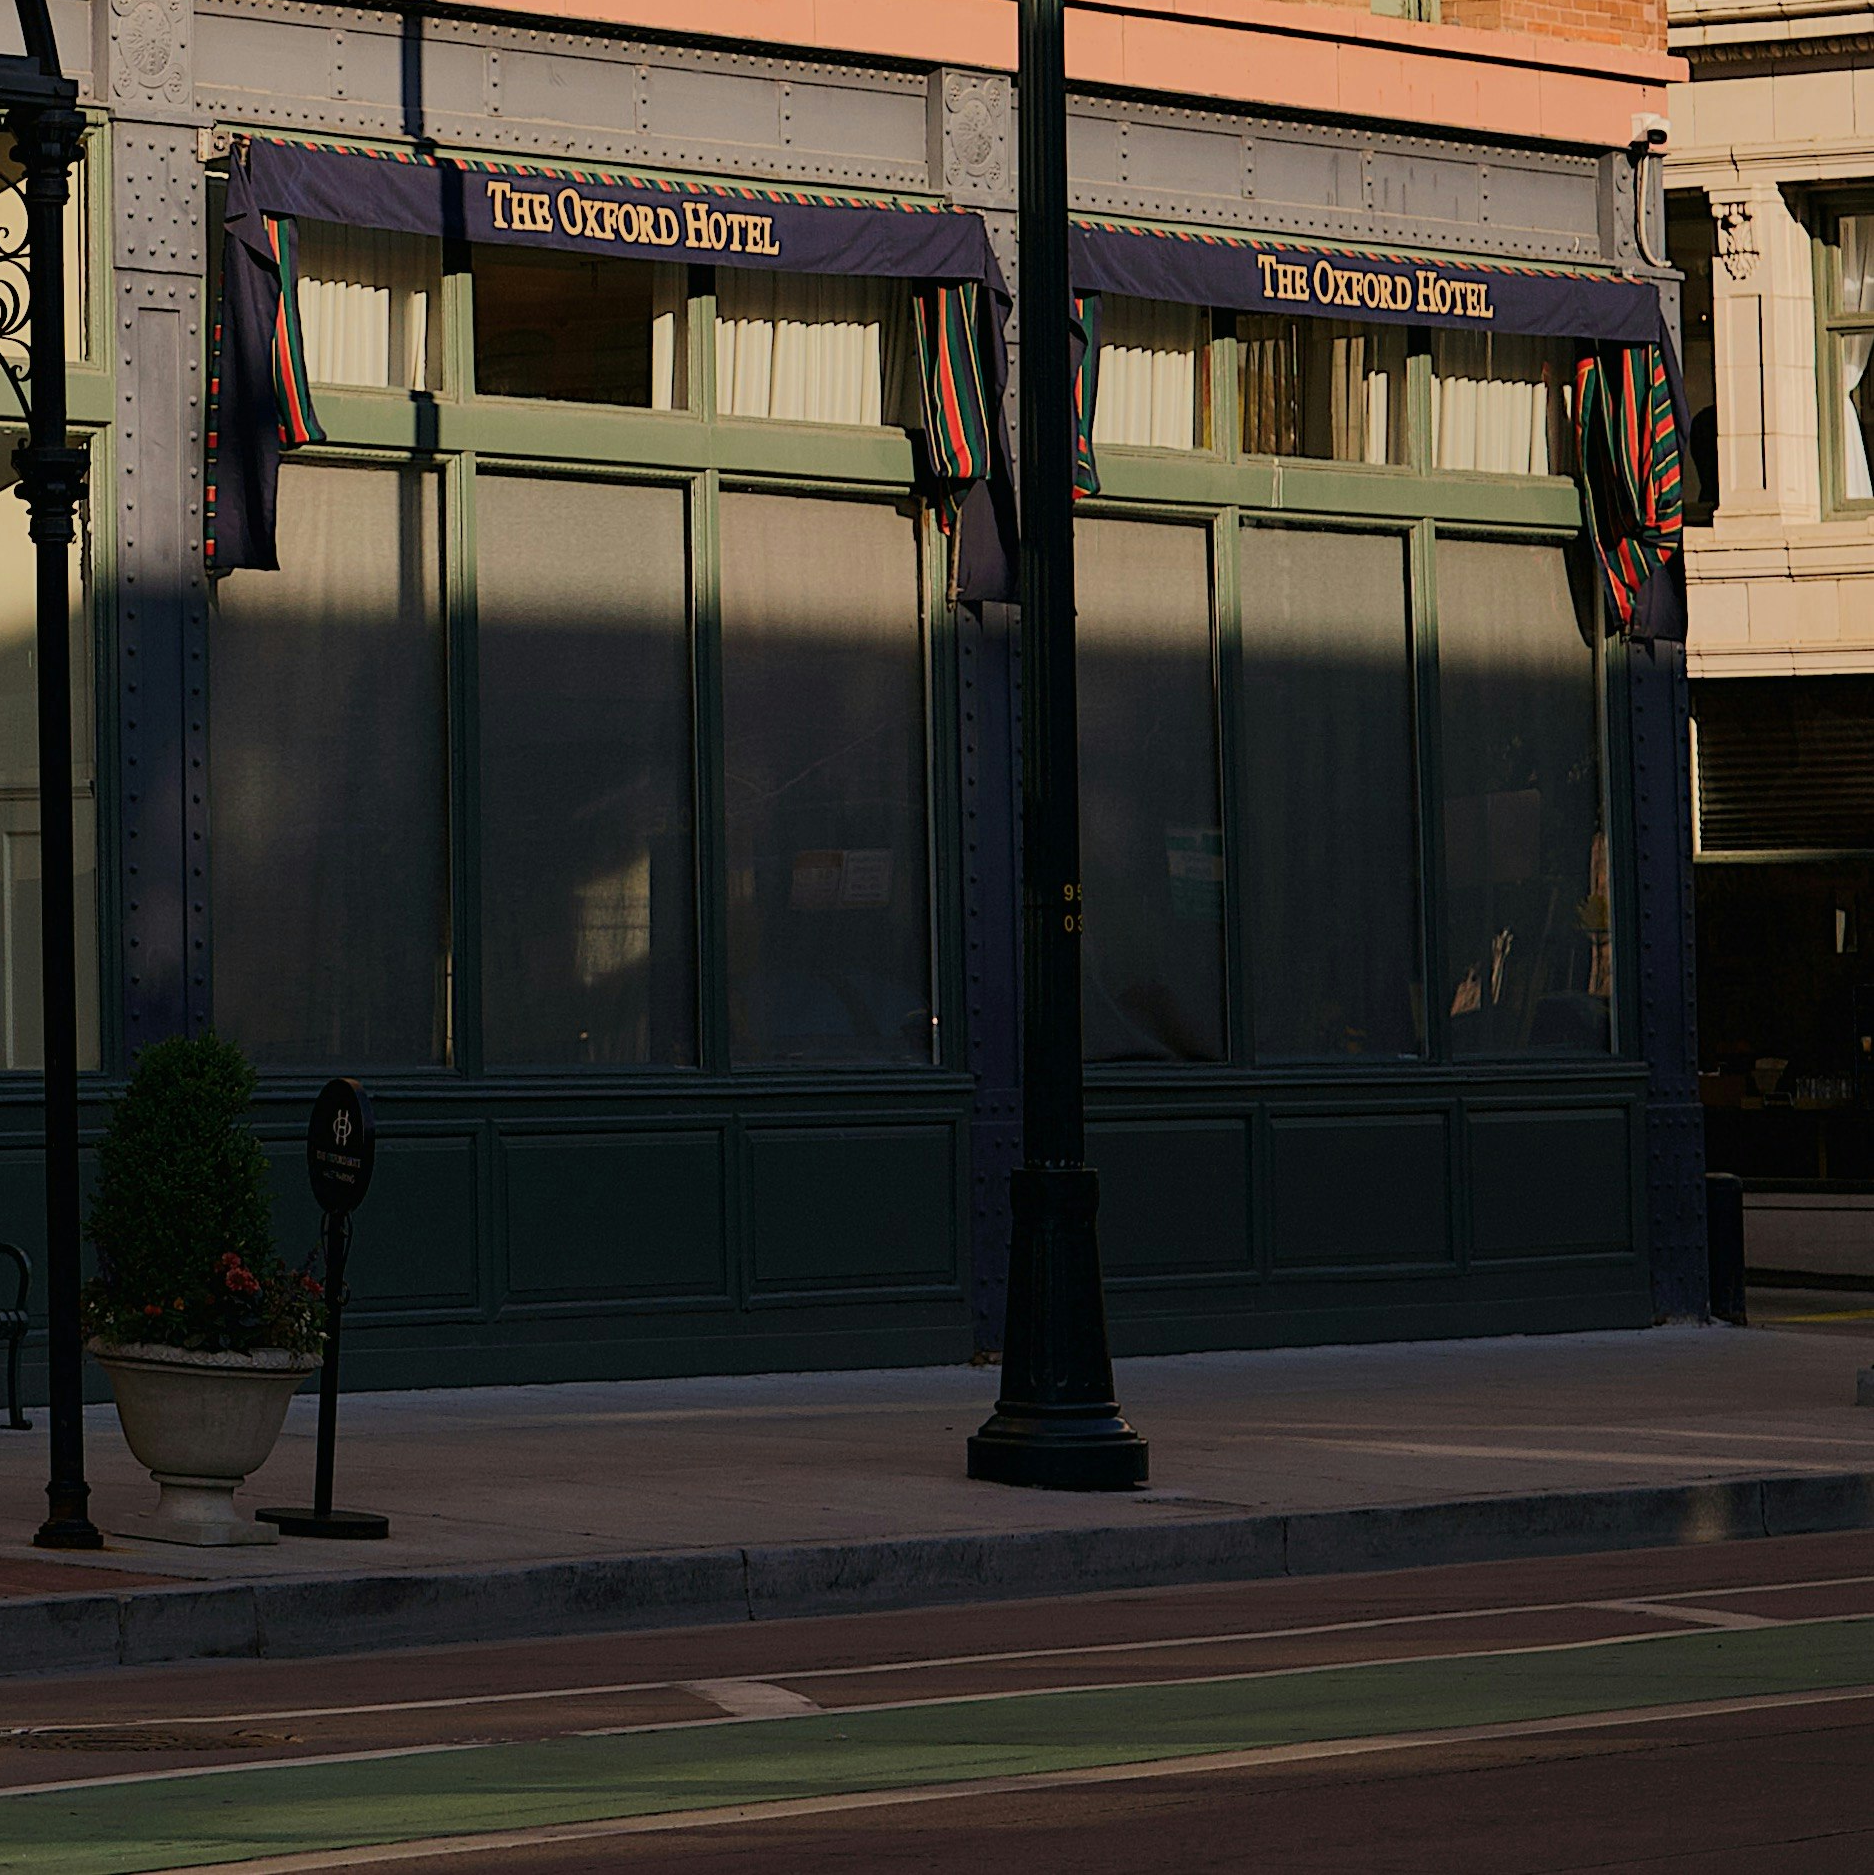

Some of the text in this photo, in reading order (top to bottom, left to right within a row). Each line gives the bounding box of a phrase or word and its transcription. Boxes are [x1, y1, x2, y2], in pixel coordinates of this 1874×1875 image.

[487, 181, 780, 255] THE OXFORD HOTEL
[1257, 254, 1494, 318] THE OXFORD HOTEL
